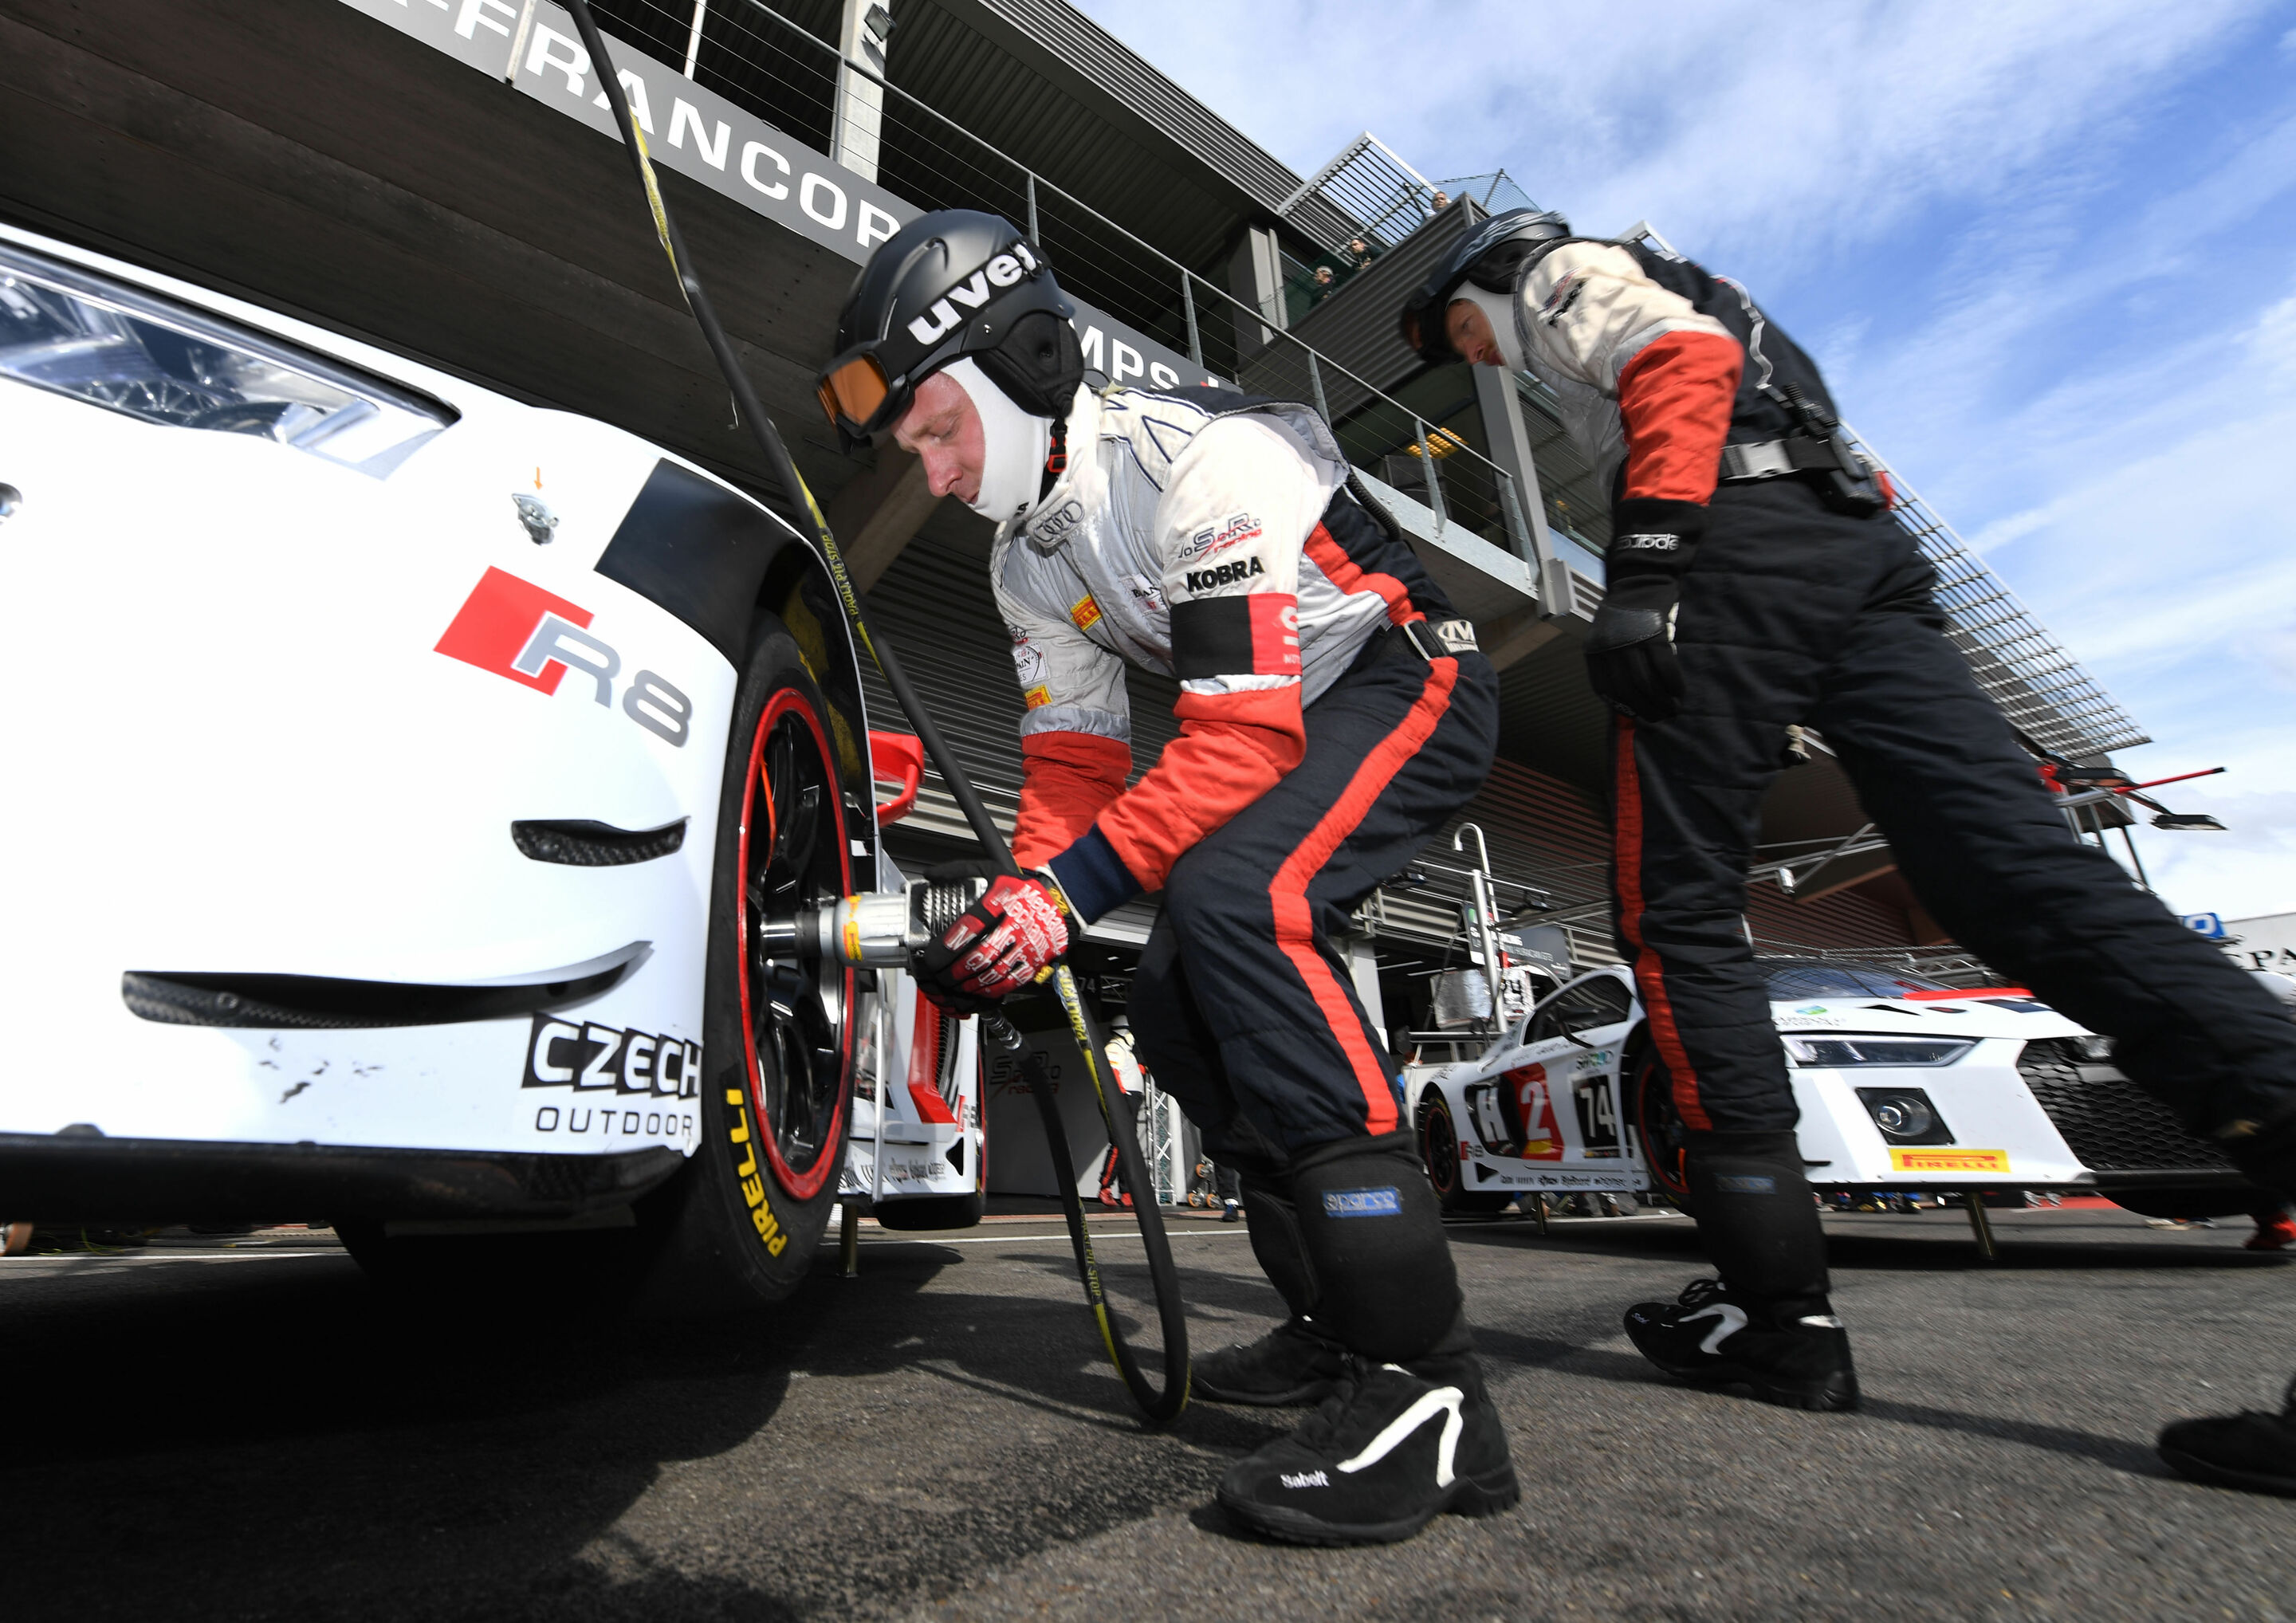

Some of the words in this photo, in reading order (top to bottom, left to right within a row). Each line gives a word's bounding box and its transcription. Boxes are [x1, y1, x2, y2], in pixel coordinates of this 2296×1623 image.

[822, 534, 840, 561] STOP
[1617, 533, 1680, 551] sparc
[832, 560, 846, 583] PIT
[1187, 556, 1265, 592] KOBRA
[839, 583, 859, 616] PAOLI
[515, 614, 693, 749] R8
[1067, 1001, 1087, 1040] PAOLI
[533, 1021, 702, 1097] CZECH
[536, 1106, 693, 1137] OUTDOOR
[1520, 1080, 1552, 1142] 2
[1579, 1083, 1618, 1138] 74
[725, 1088, 788, 1257] PIRELLI
[1901, 1153, 1999, 1169] PIRELLI
